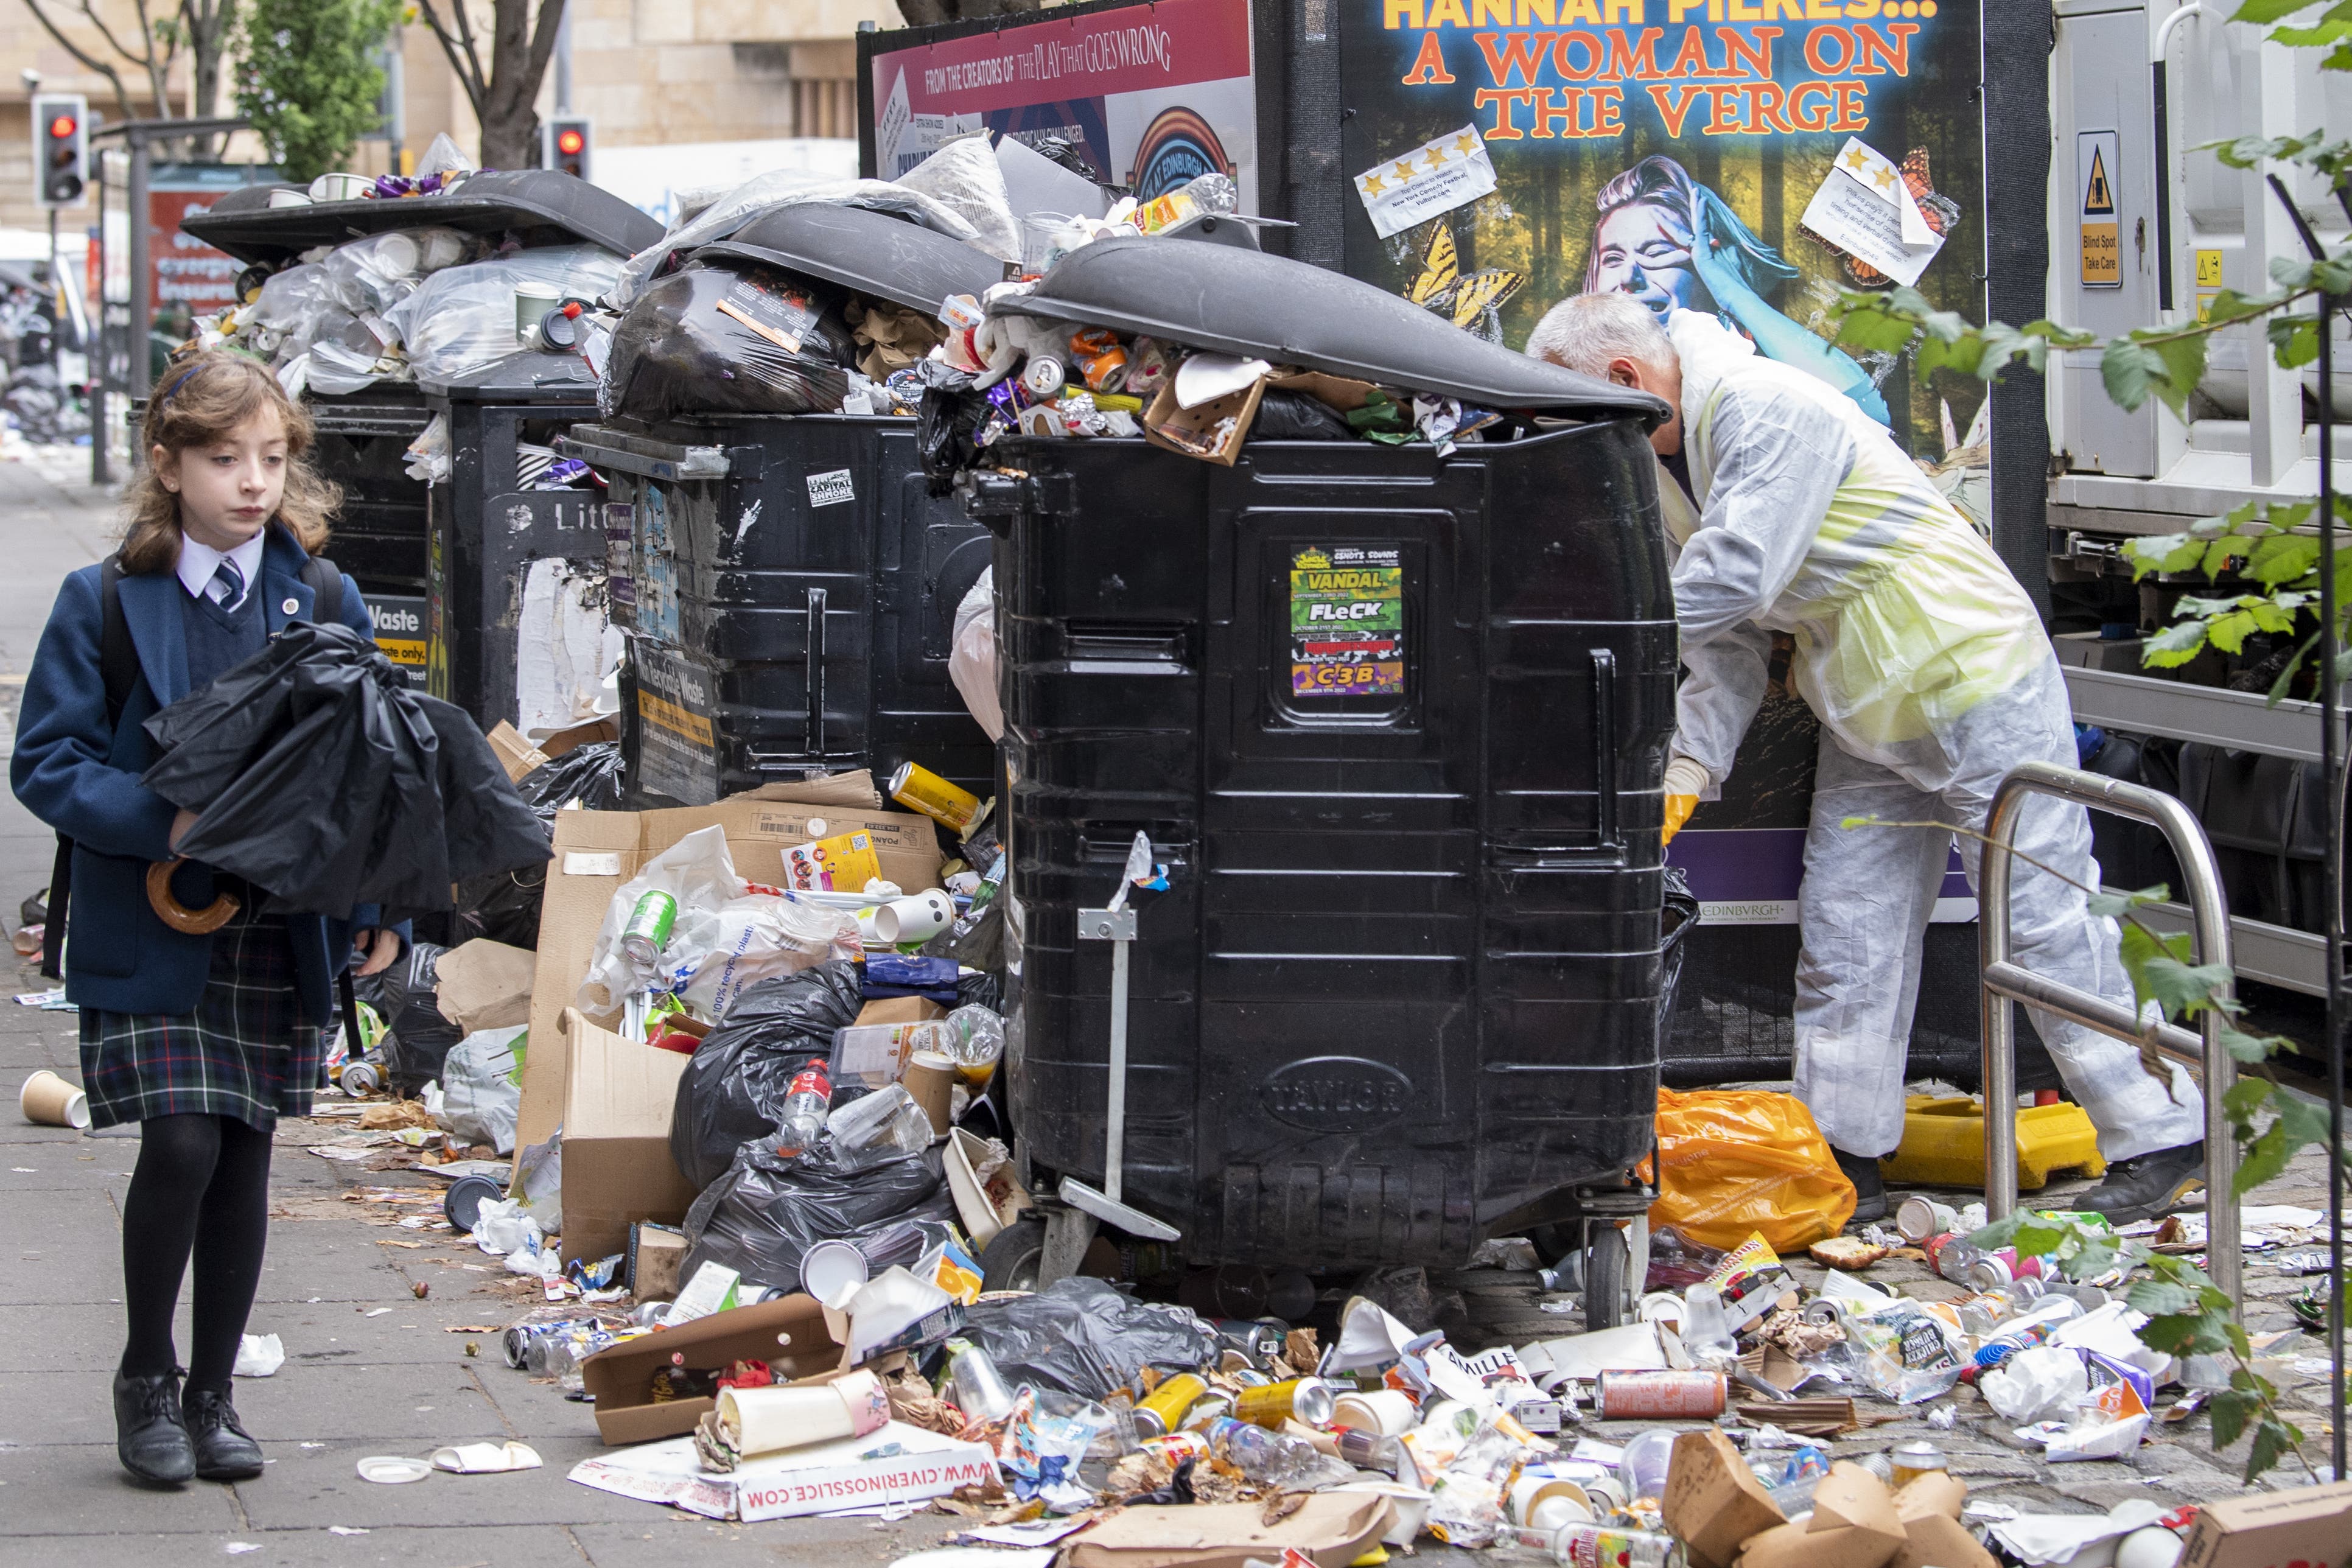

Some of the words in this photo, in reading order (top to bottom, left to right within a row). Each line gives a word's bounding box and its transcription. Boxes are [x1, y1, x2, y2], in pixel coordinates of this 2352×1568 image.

[1384, 0, 1644, 29] HANNAH
[925, 67, 946, 95] FROM
[947, 64, 962, 91] THE
[962, 57, 1003, 89] CREATORS
[1003, 55, 1014, 83] OF
[1017, 52, 1035, 80] THE
[1034, 40, 1061, 80] PLAY
[1060, 44, 1084, 74] THAT
[1085, 30, 1117, 73] GOES
[1115, 24, 1171, 72] WRONG
[1402, 30, 1455, 85] A
[1474, 24, 1783, 86] WOMAN
[1804, 23, 1920, 77] ON
[1474, 86, 1625, 140] THE
[1645, 80, 1869, 138] VERGE
[1161, 152, 1202, 178] EDINBURGH
[1401, 186, 1412, 195] Top
[1435, 170, 1453, 180] Watch
[1391, 198, 1405, 208] New
[1405, 192, 1419, 203] York
[1419, 183, 1443, 197] Comedy
[1416, 188, 1451, 206] Vulture.com
[1844, 198, 1855, 209] her
[1855, 205, 1875, 221] sense
[1875, 217, 1883, 226] of
[1865, 201, 1883, 216] plays
[1830, 201, 1850, 218] timing
[1850, 214, 1863, 226] and
[1863, 223, 1881, 239] verbal
[1882, 234, 1912, 258] dynamics
[2084, 236, 2099, 248] Blind
[2101, 235, 2116, 251] Spot
[2085, 256, 2099, 270] Take
[2101, 256, 2116, 270] Care
[810, 480, 852, 494] CAPITAL
[556, 503, 609, 530] Litt
[1309, 602, 1383, 621] FLeCK
[380, 645, 399, 660] aste
[402, 645, 425, 665] only.
[679, 670, 705, 706] Waste
[713, 988, 727, 1013] 100%
[721, 952, 742, 986] recycd
[1272, 1080, 1401, 1111] TAYLOR
[1661, 1149, 1709, 1167] veryone
[1903, 1328, 1937, 1353] BURGER
[1906, 1340, 1942, 1365] CHICKEN
[746, 1461, 994, 1508] WWW.CIVERINOSSLICE.COM
